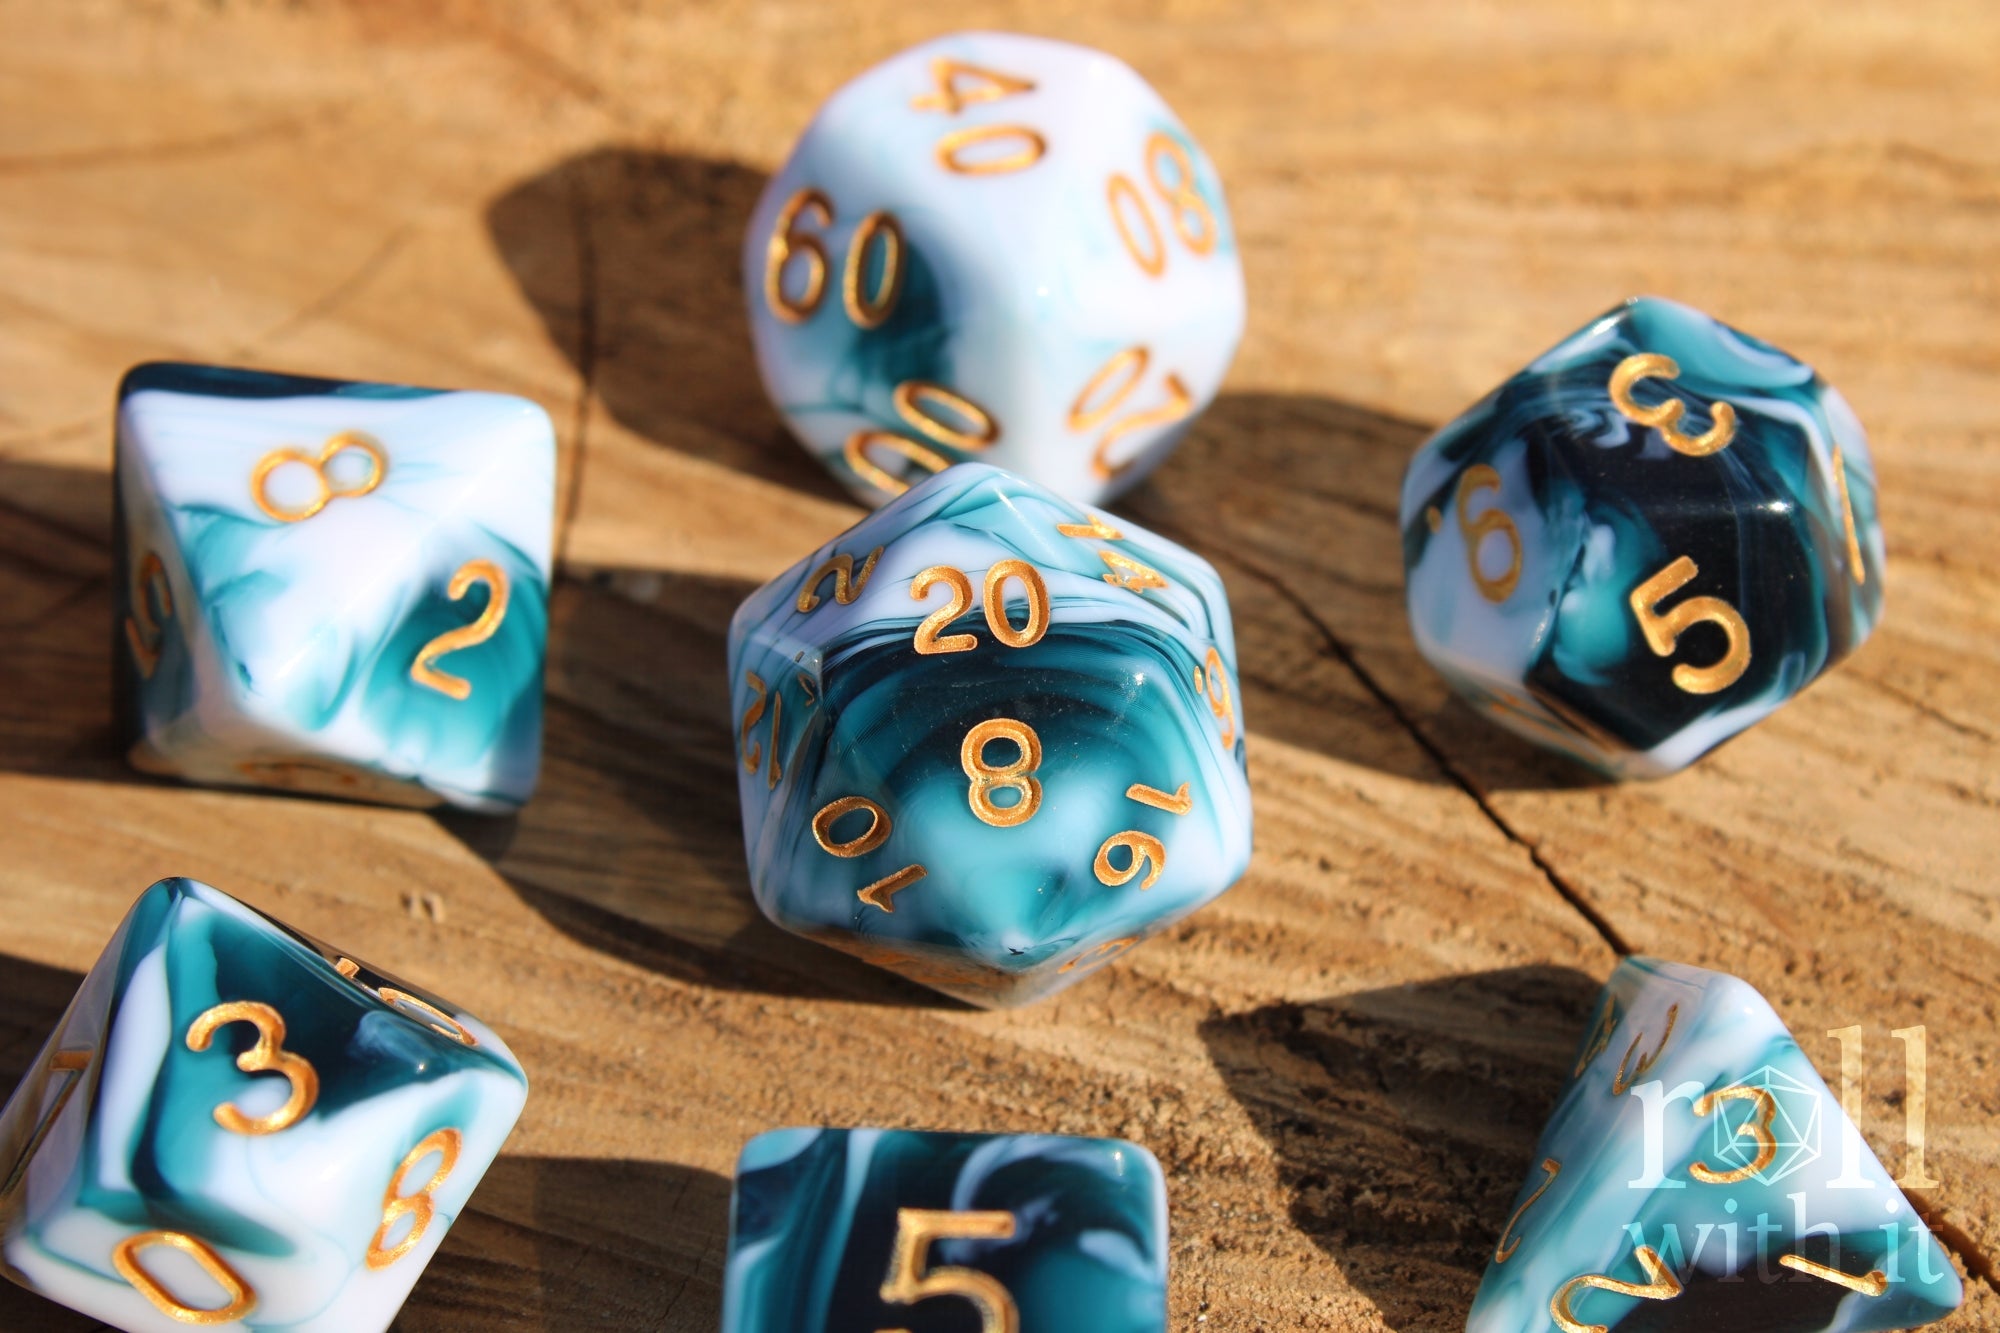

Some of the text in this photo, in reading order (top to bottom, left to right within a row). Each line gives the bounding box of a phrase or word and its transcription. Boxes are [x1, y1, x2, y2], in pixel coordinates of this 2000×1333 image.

[764, 187, 902, 328] 60
[1105, 131, 1218, 278] 80
[1608, 353, 1737, 456] 3
[251, 431, 386, 523] 8
[409, 558, 511, 701] 2
[909, 558, 1051, 655] 20
[1630, 556, 1752, 695] 5
[961, 718, 1043, 827] 8
[185, 1000, 319, 1136] 3
[1689, 1086, 1778, 1184] 3
[366, 1128, 463, 1271] 8
[112, 1229, 258, 1325] 0
[874, 1208, 1020, 1333] 5
